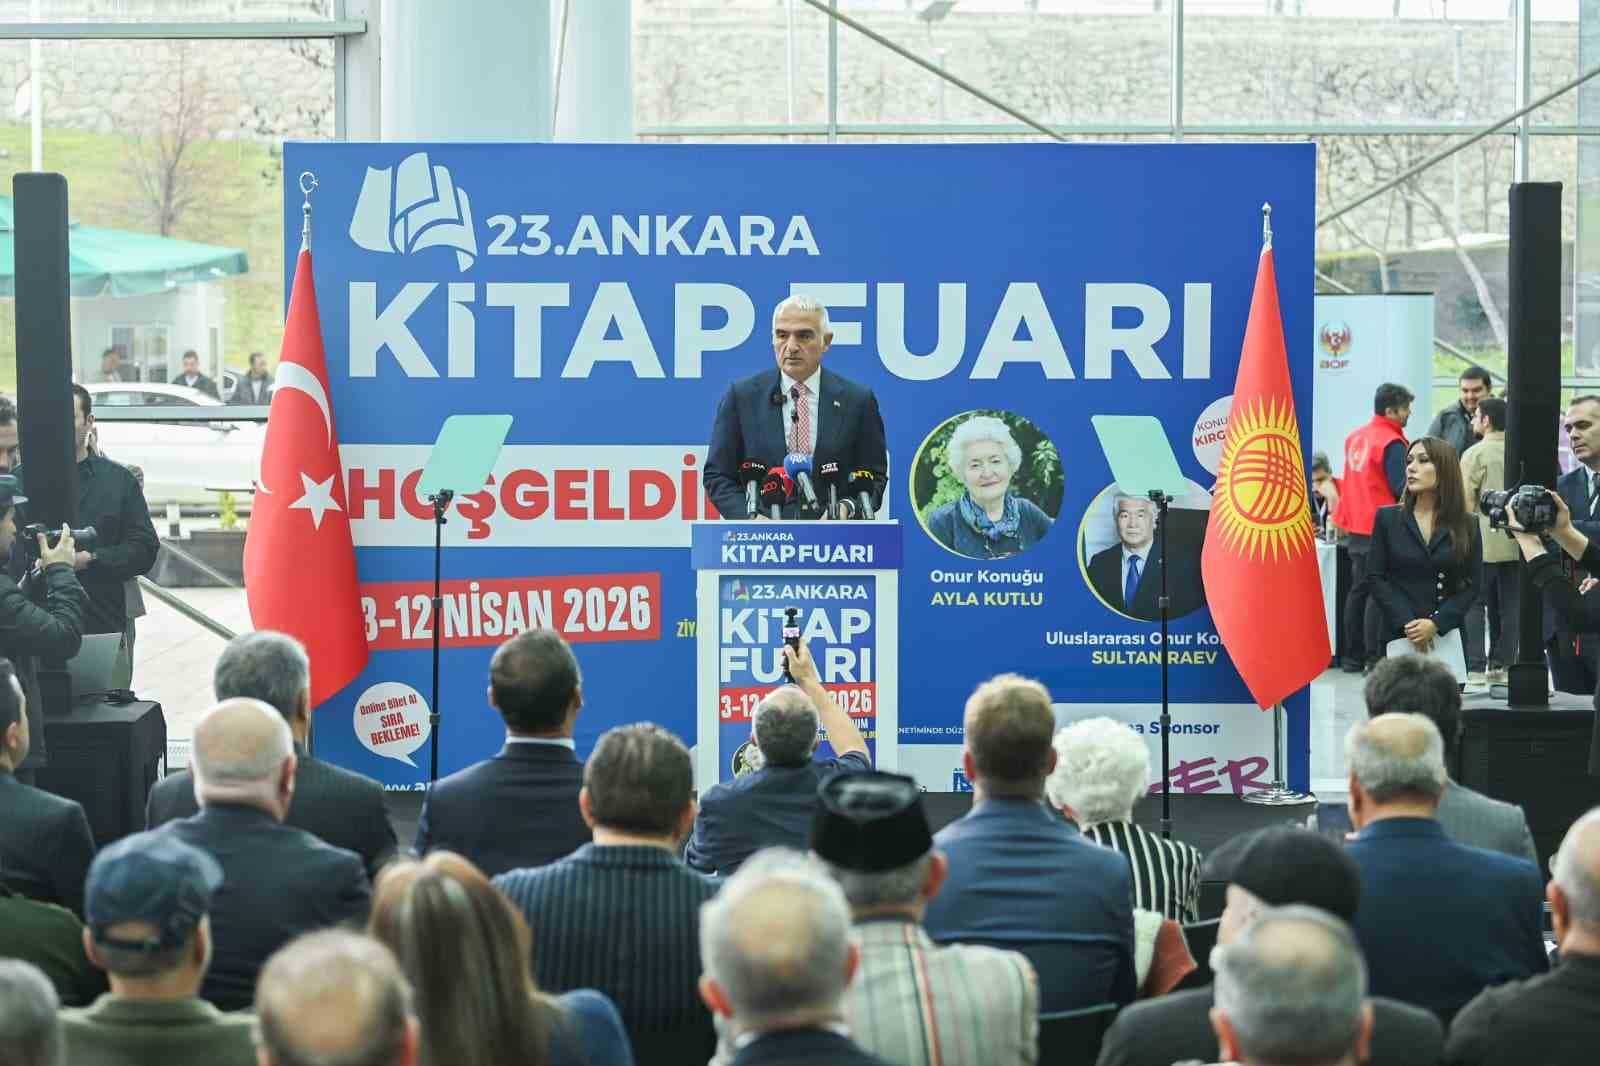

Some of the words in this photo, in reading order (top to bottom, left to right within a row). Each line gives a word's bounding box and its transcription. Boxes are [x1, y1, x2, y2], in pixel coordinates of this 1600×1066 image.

[486, 213, 821, 257] 23.ANKARA
[349, 281, 756, 379] KİTAP
[1197, 416, 1229, 432] KONU
[1195, 430, 1226, 447] KIRG
[348, 453, 720, 540] HOŞGELDİ
[736, 532, 794, 541] 23.ANKARA
[798, 544, 874, 563] FUARI
[930, 569, 973, 584] Onur
[977, 569, 1044, 586] Konuğu
[751, 584, 868, 600] 23.ANKARA
[930, 591, 980, 606] AYLA
[983, 591, 1044, 606] KUTLU
[361, 593, 433, 642] 3-12
[442, 582, 552, 639] NİSAN
[563, 585, 651, 633] 2026
[676, 618, 697, 638] ZİY
[1045, 631, 1145, 646] Uluslararası
[1196, 631, 1223, 646] Ko
[1091, 650, 1163, 665] SULTAN
[1166, 650, 1218, 665] RAEV
[360, 701, 387, 716] Online
[380, 711, 405, 729] SIRA
[370, 722, 421, 746] BEKLEME!
